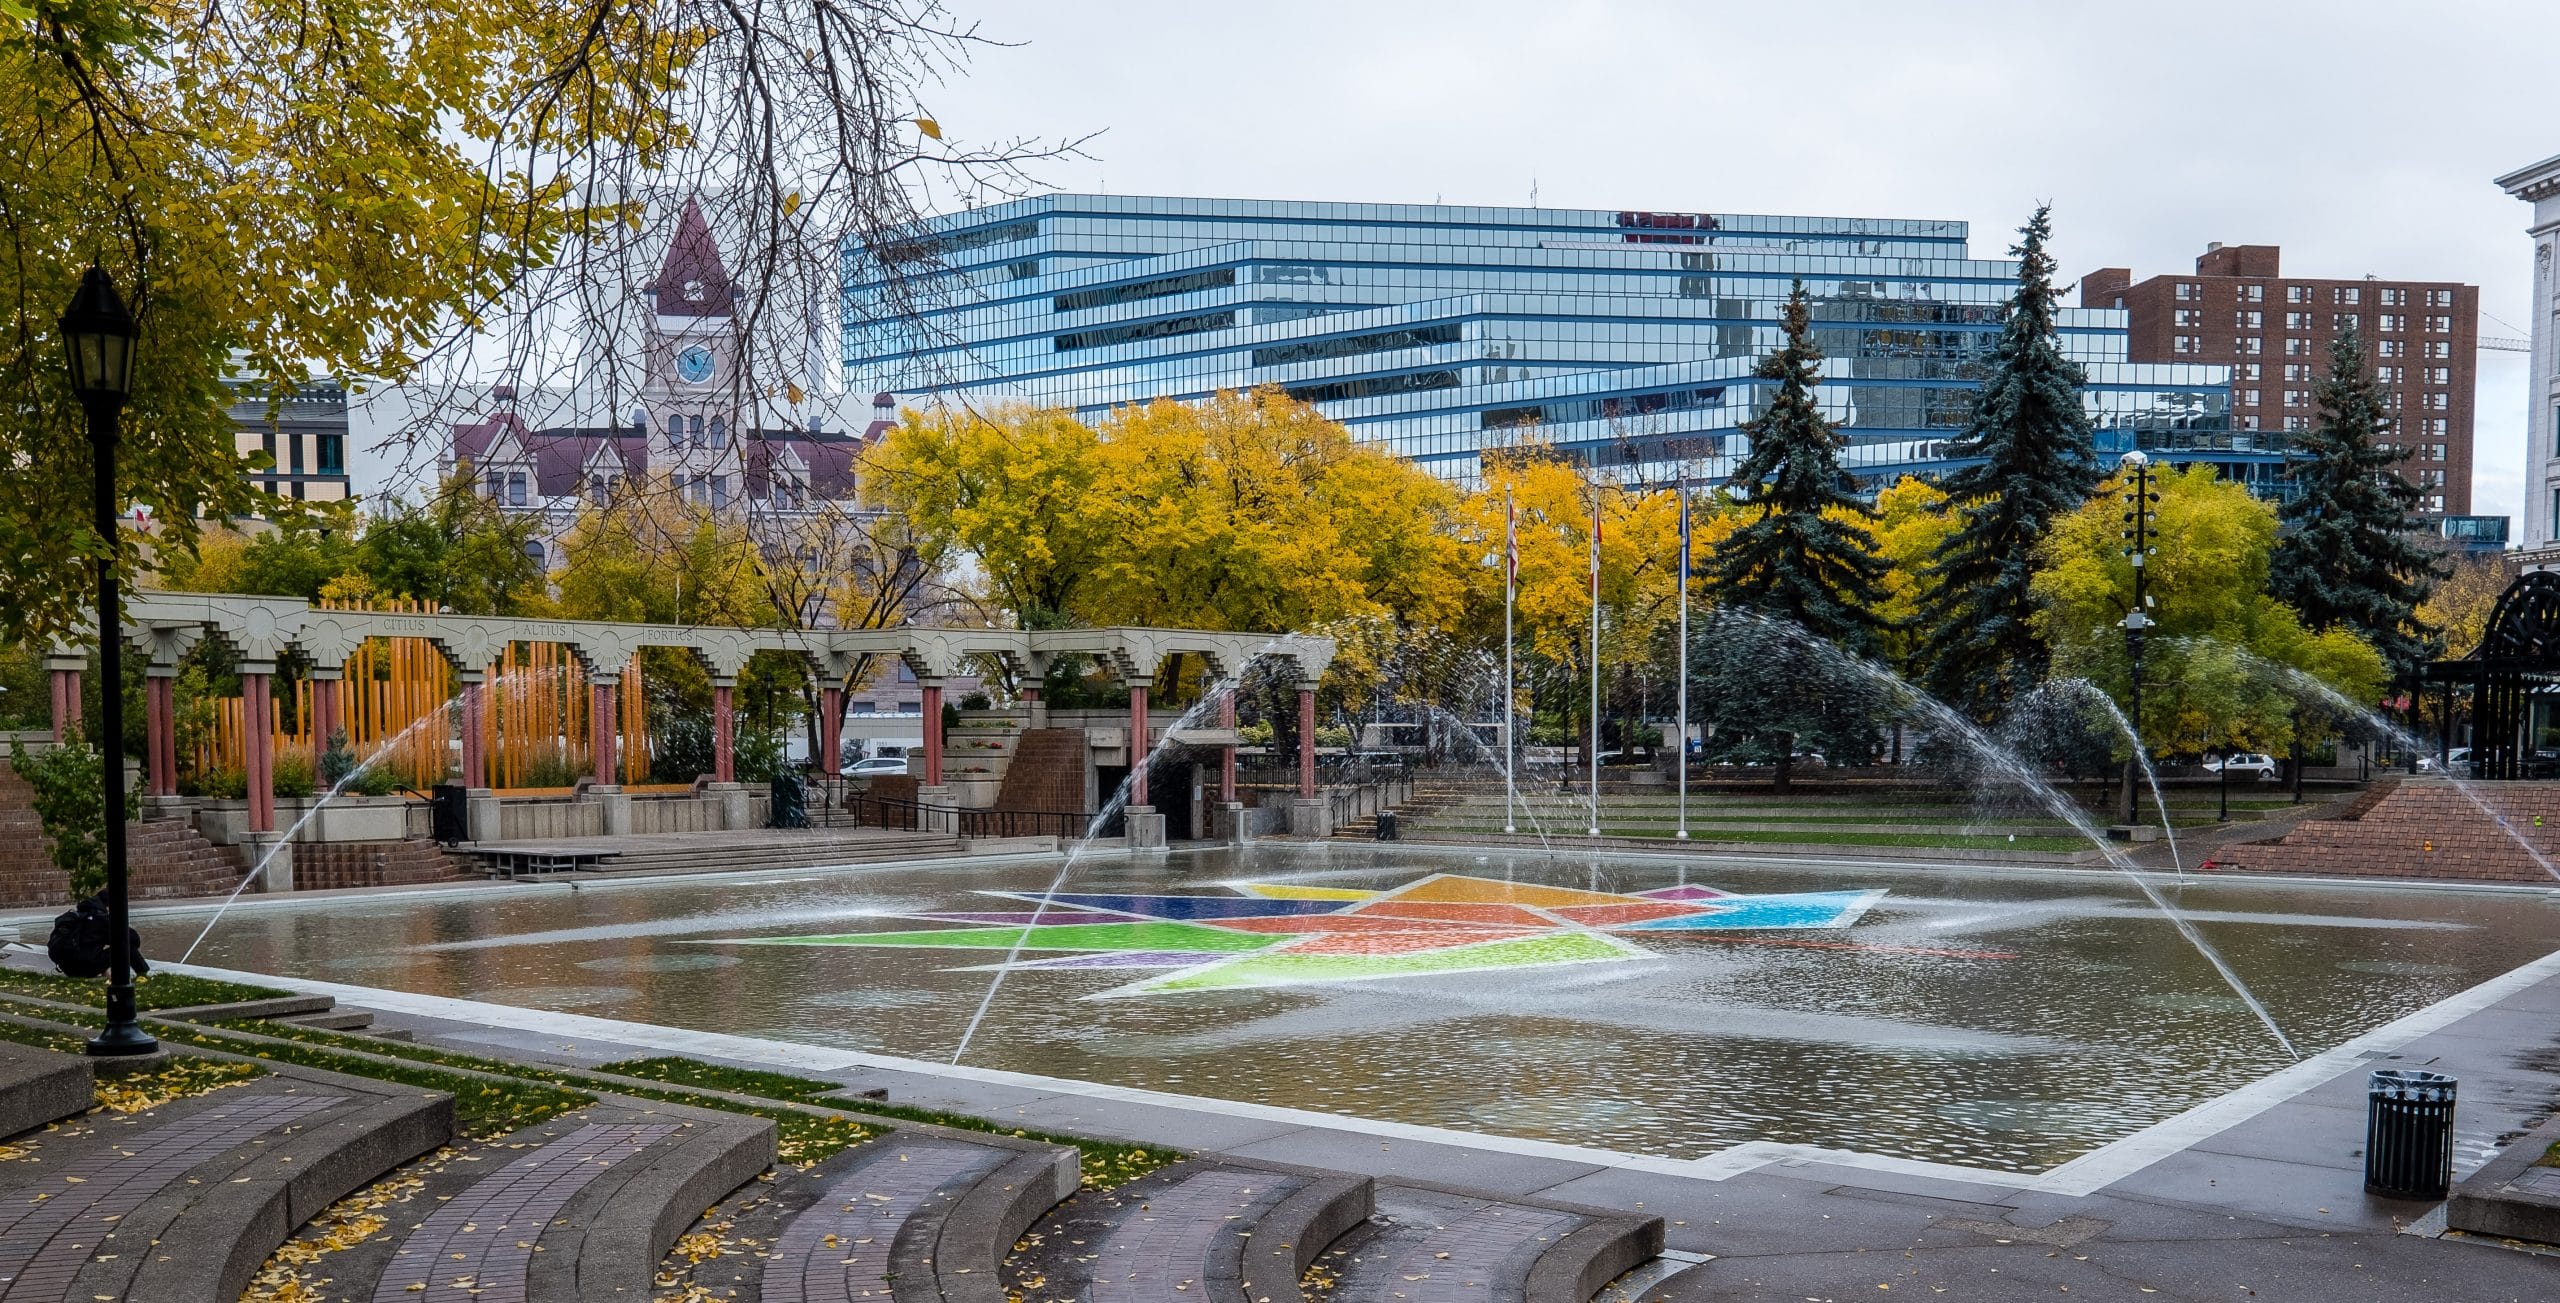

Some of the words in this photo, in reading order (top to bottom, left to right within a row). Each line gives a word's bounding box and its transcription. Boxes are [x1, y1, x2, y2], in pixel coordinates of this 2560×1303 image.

[383, 618, 426, 631] CITIUS
[523, 624, 567, 637] ALTIUS
[647, 629, 694, 641] FORTIUS
